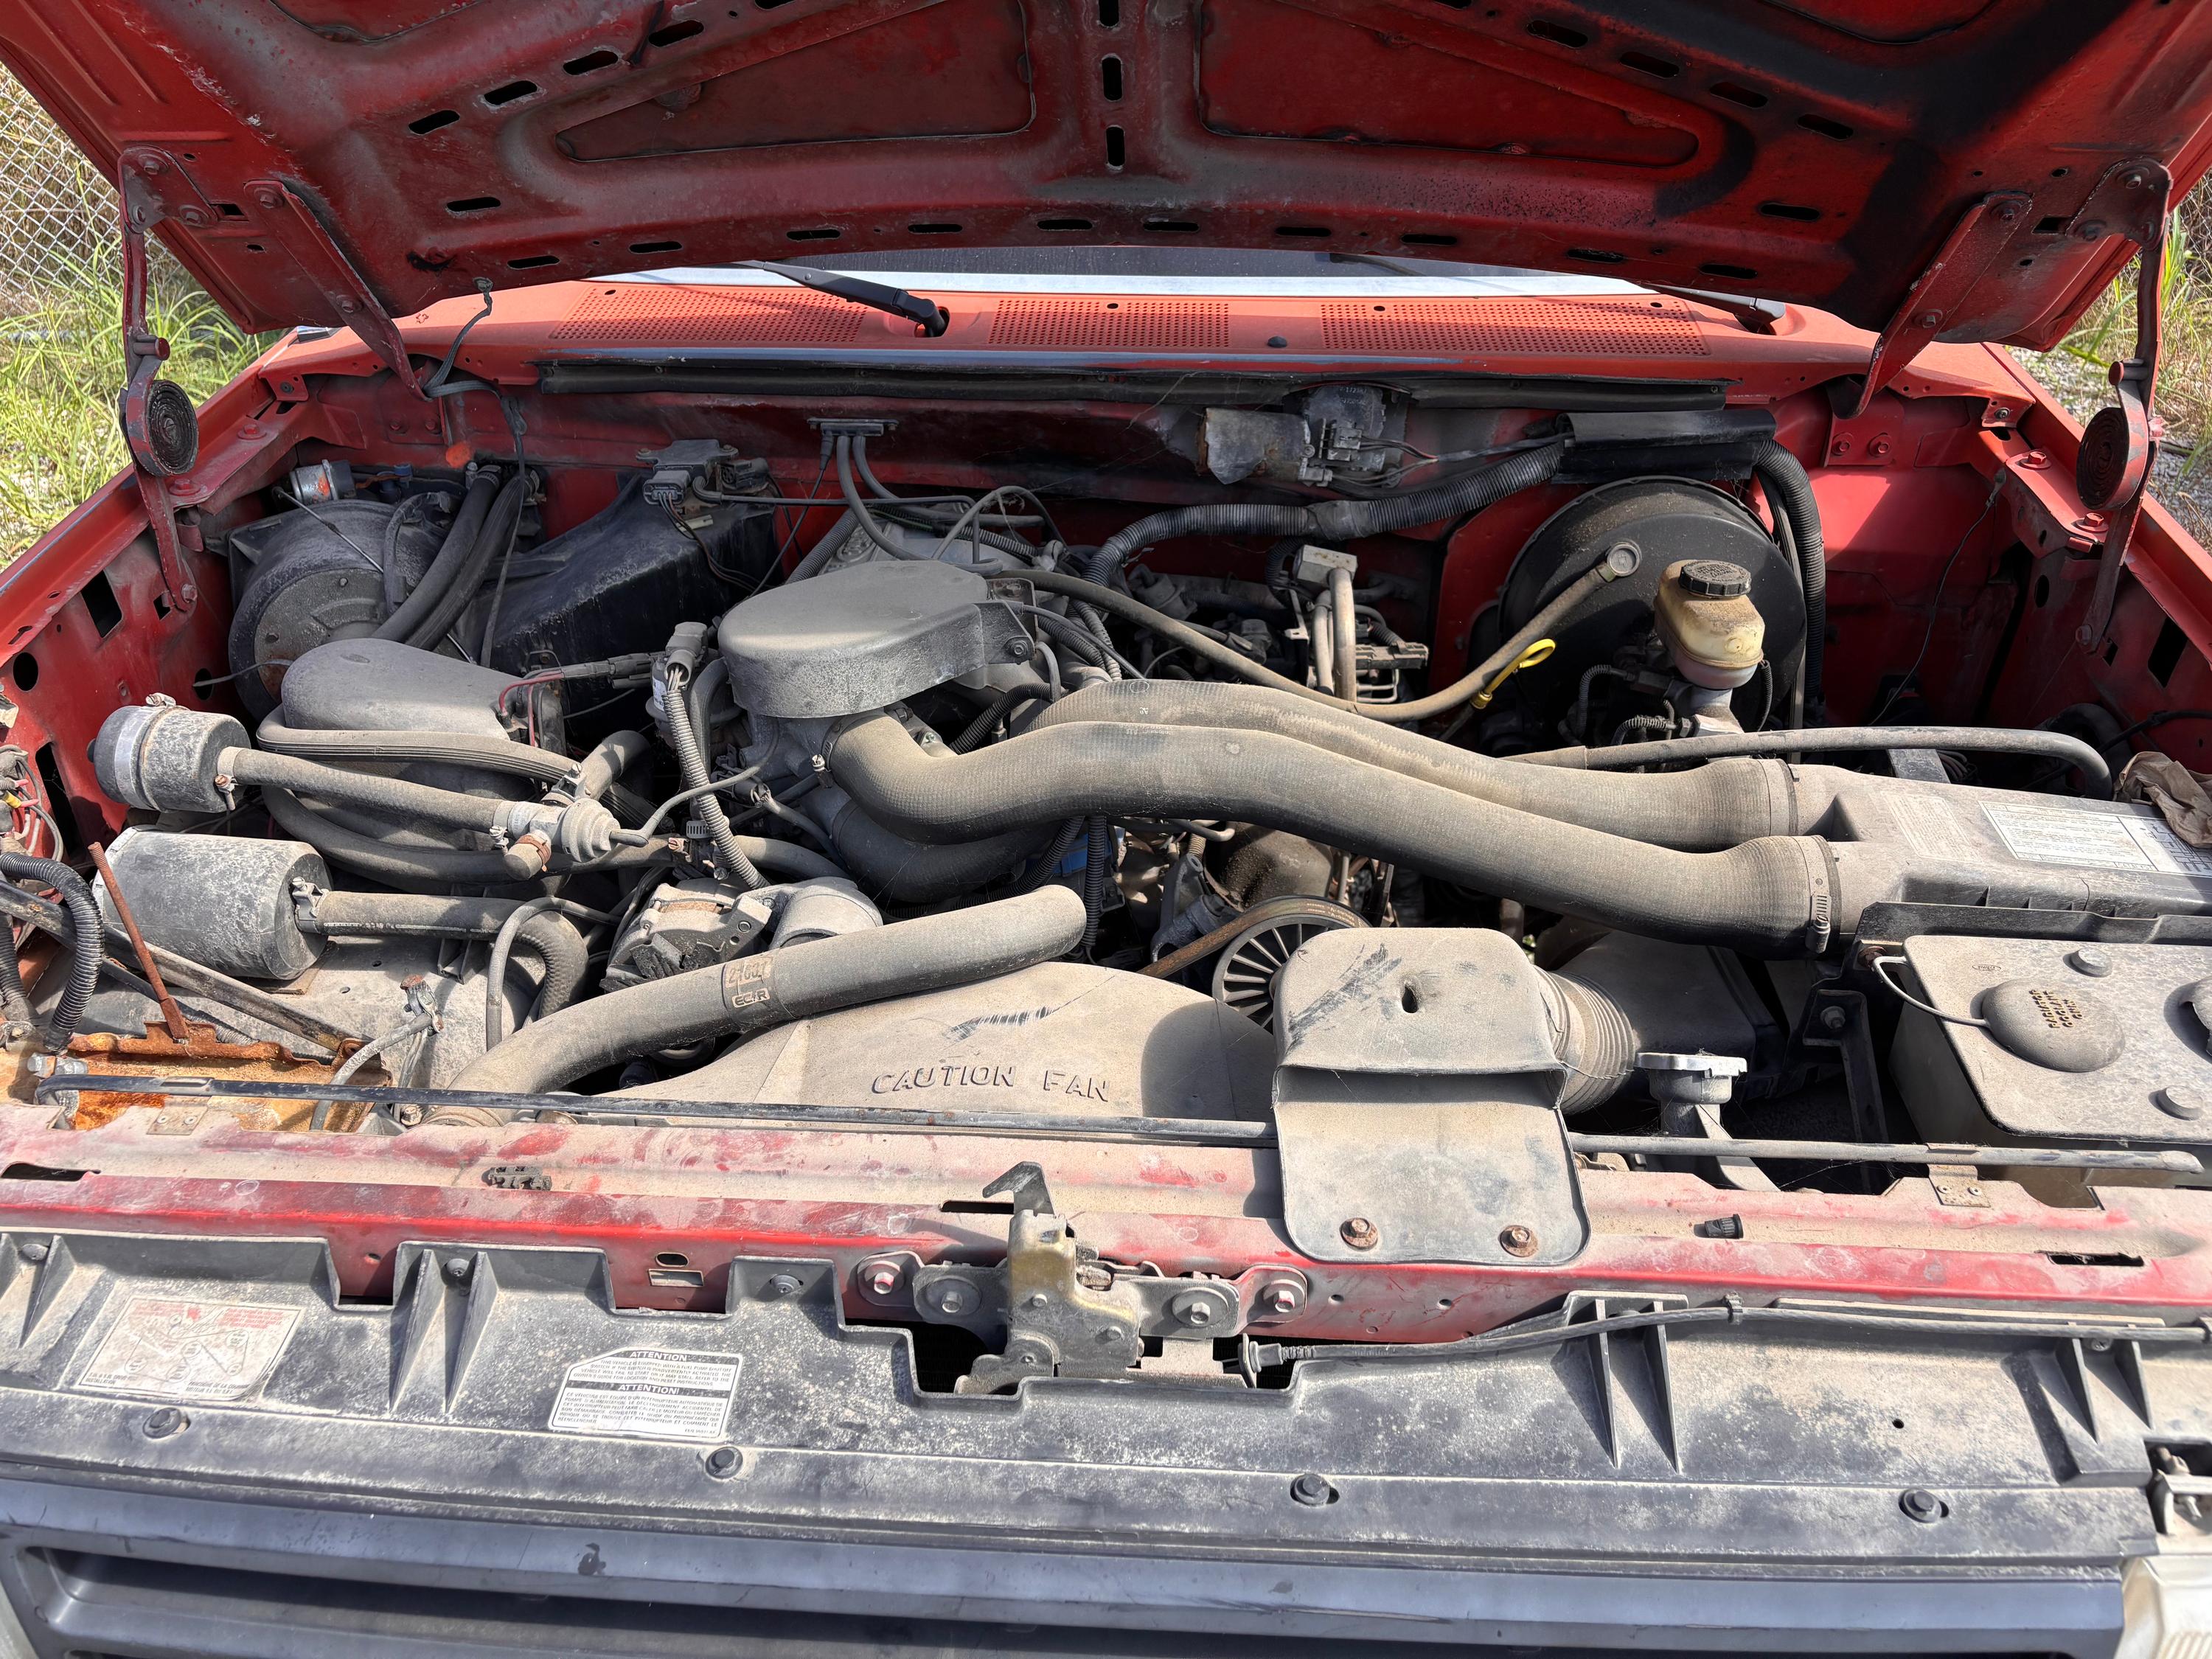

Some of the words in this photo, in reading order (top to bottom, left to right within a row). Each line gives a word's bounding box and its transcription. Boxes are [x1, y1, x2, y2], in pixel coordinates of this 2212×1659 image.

[2028, 990, 2060, 1029] RADIATOR
[2042, 991, 2074, 1028] COOLANT
[2062, 999, 2083, 1020] ONLY
[872, 1065, 1016, 1094] CAUTION
[1043, 1069, 1110, 1102] FAN
[629, 1351, 687, 1362] ATTENTION
